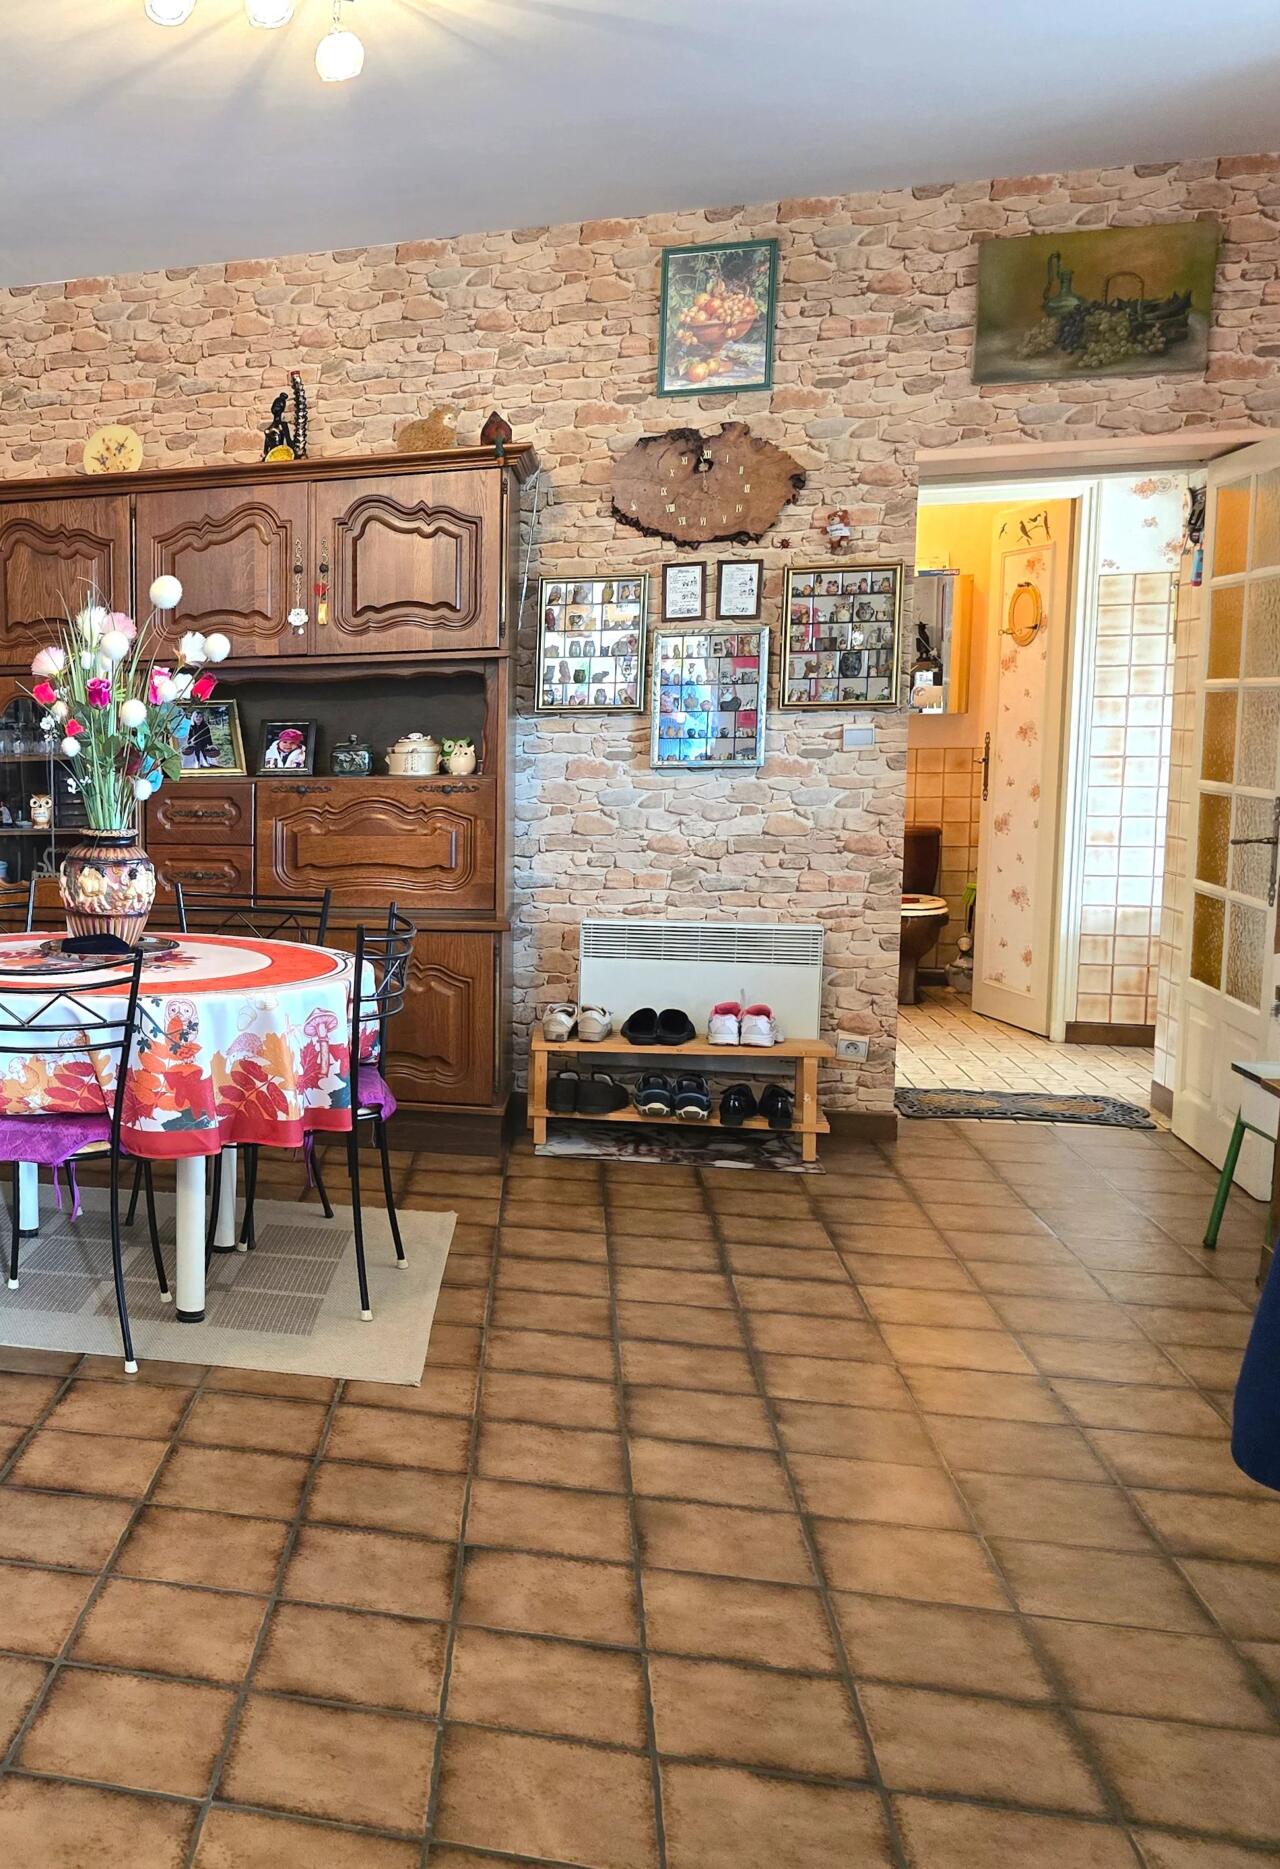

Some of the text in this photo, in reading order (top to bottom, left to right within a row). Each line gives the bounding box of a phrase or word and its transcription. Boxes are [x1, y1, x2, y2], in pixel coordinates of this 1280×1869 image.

[670, 469, 675, 477] X
[736, 504, 743, 512] IV
[700, 517, 707, 526] VI
[722, 514, 727, 524] V
